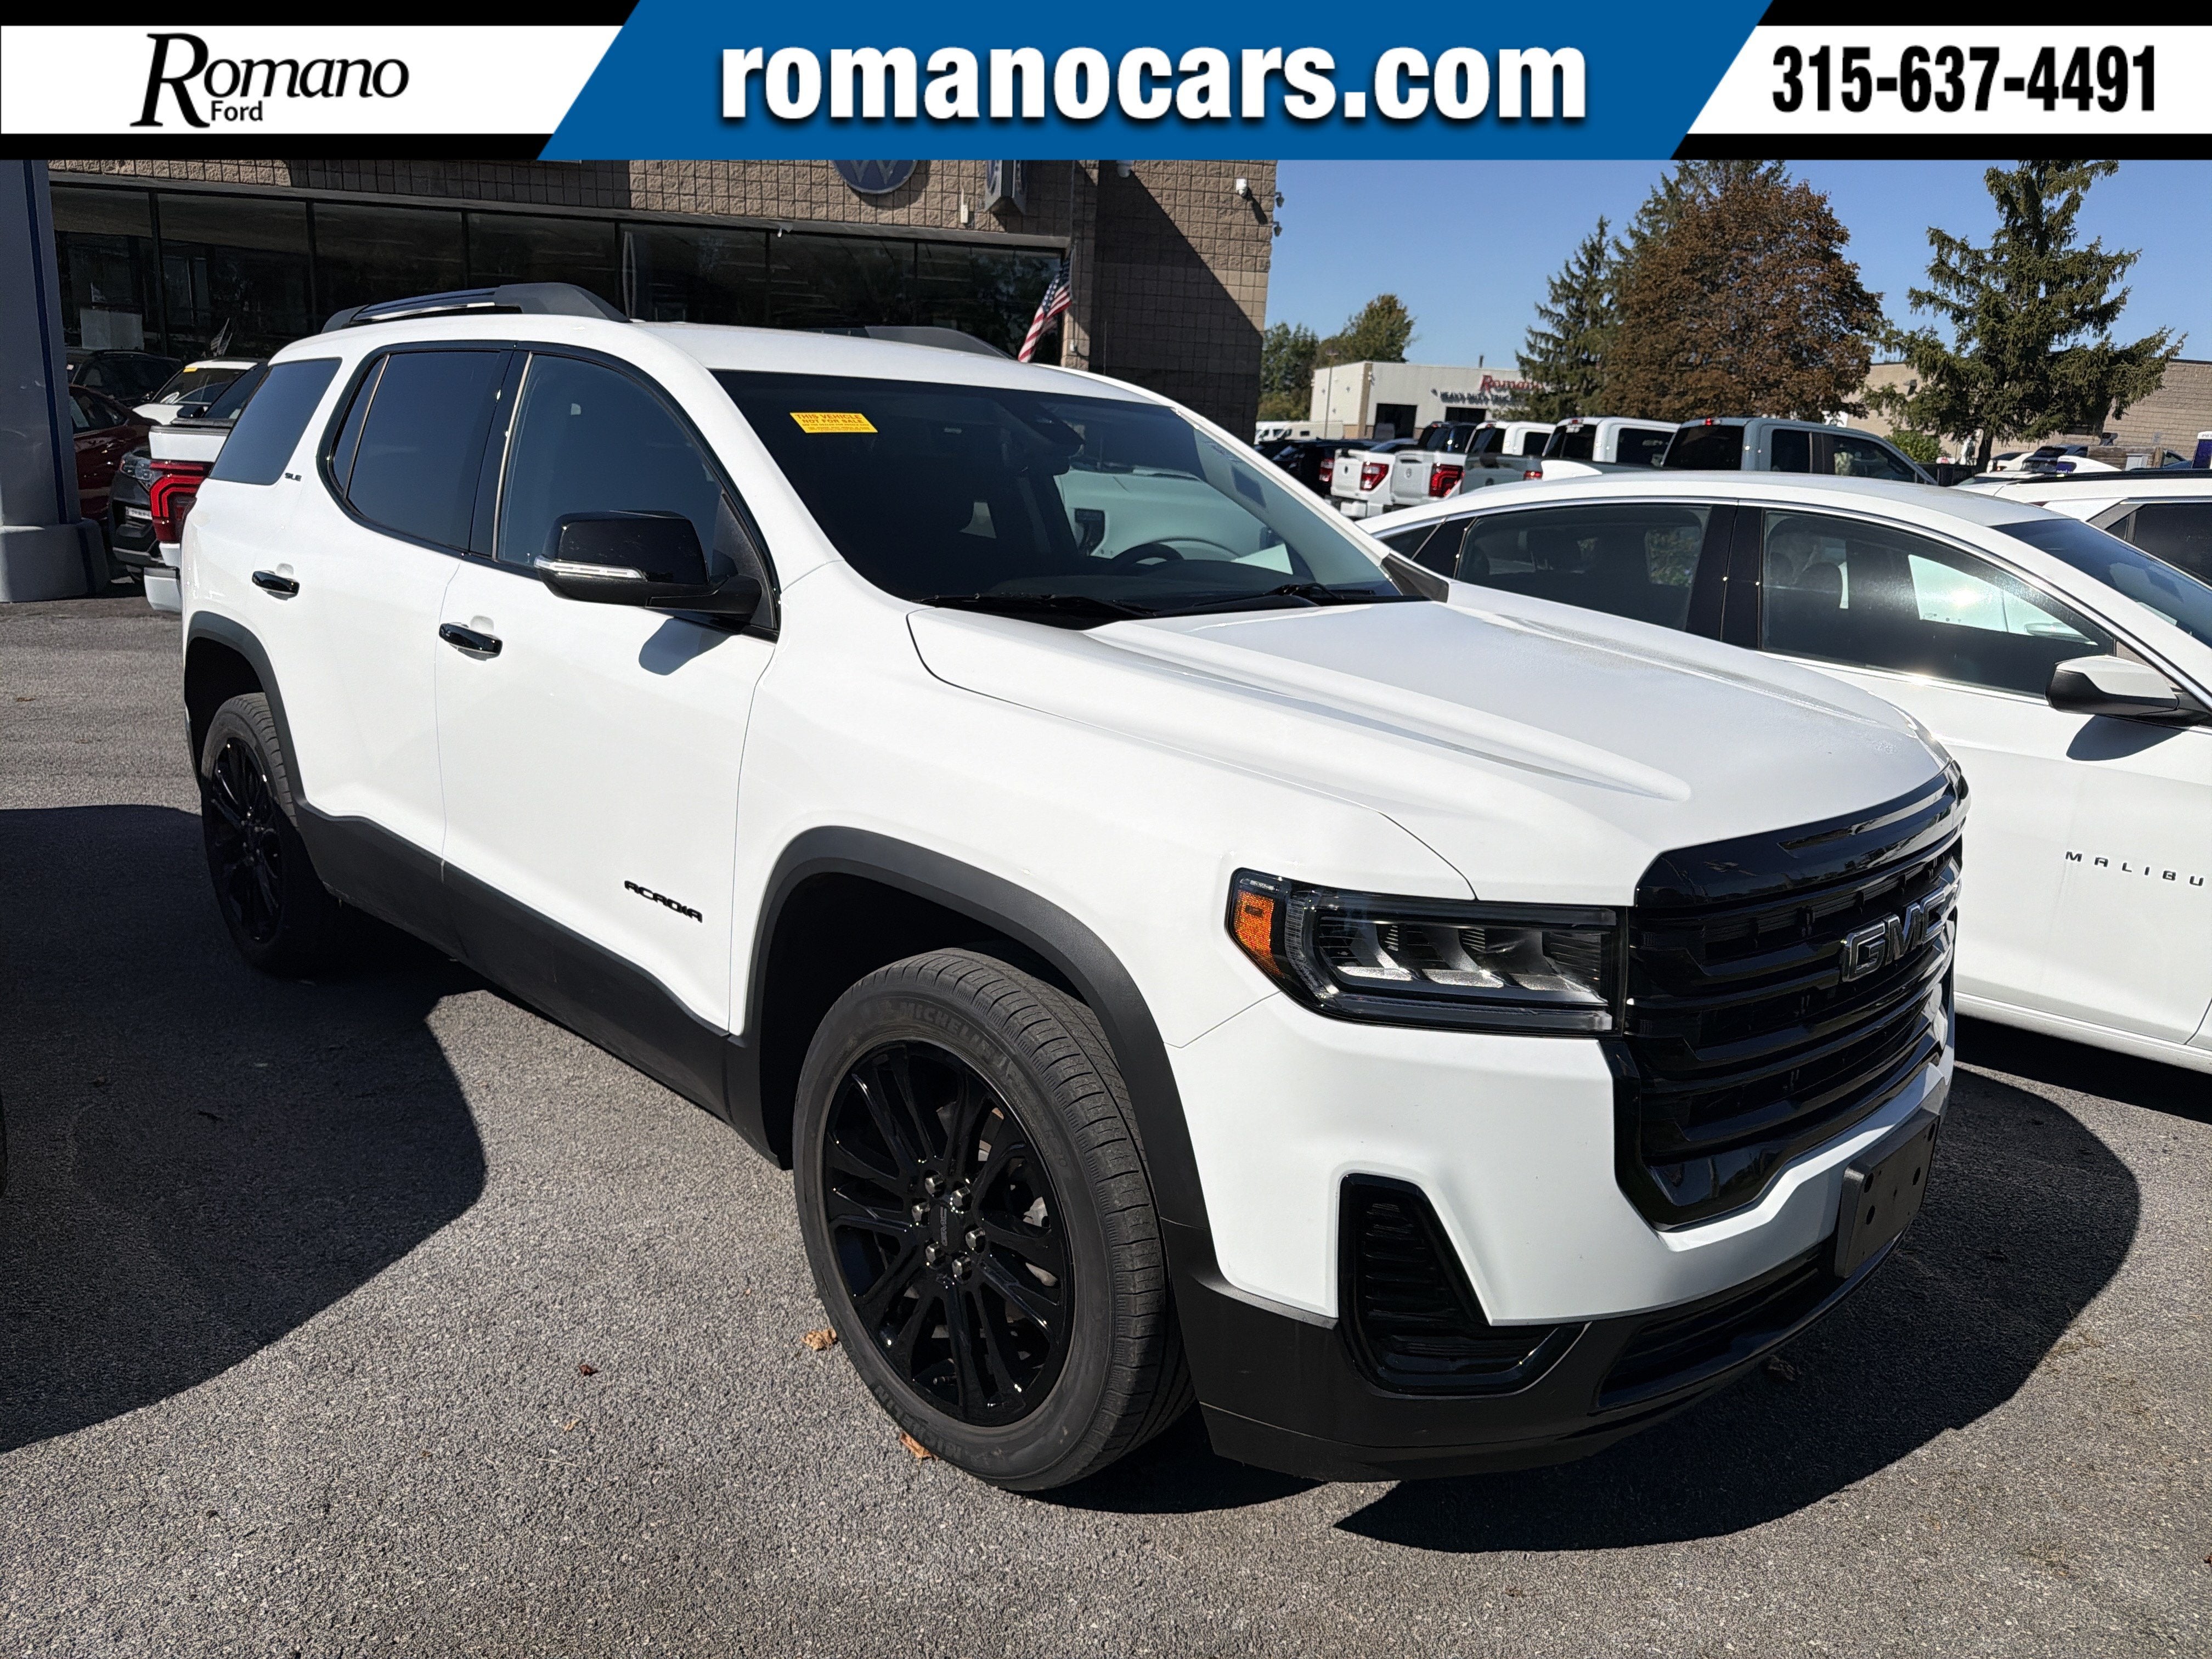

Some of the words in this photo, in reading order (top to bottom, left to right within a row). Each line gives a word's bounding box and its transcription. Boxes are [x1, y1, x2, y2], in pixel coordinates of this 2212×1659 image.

[285, 472, 302, 482] SLE
[2065, 851, 2204, 887] MALIBU
[624, 880, 703, 923] ACADIA
[1841, 886, 1946, 983] GMC
